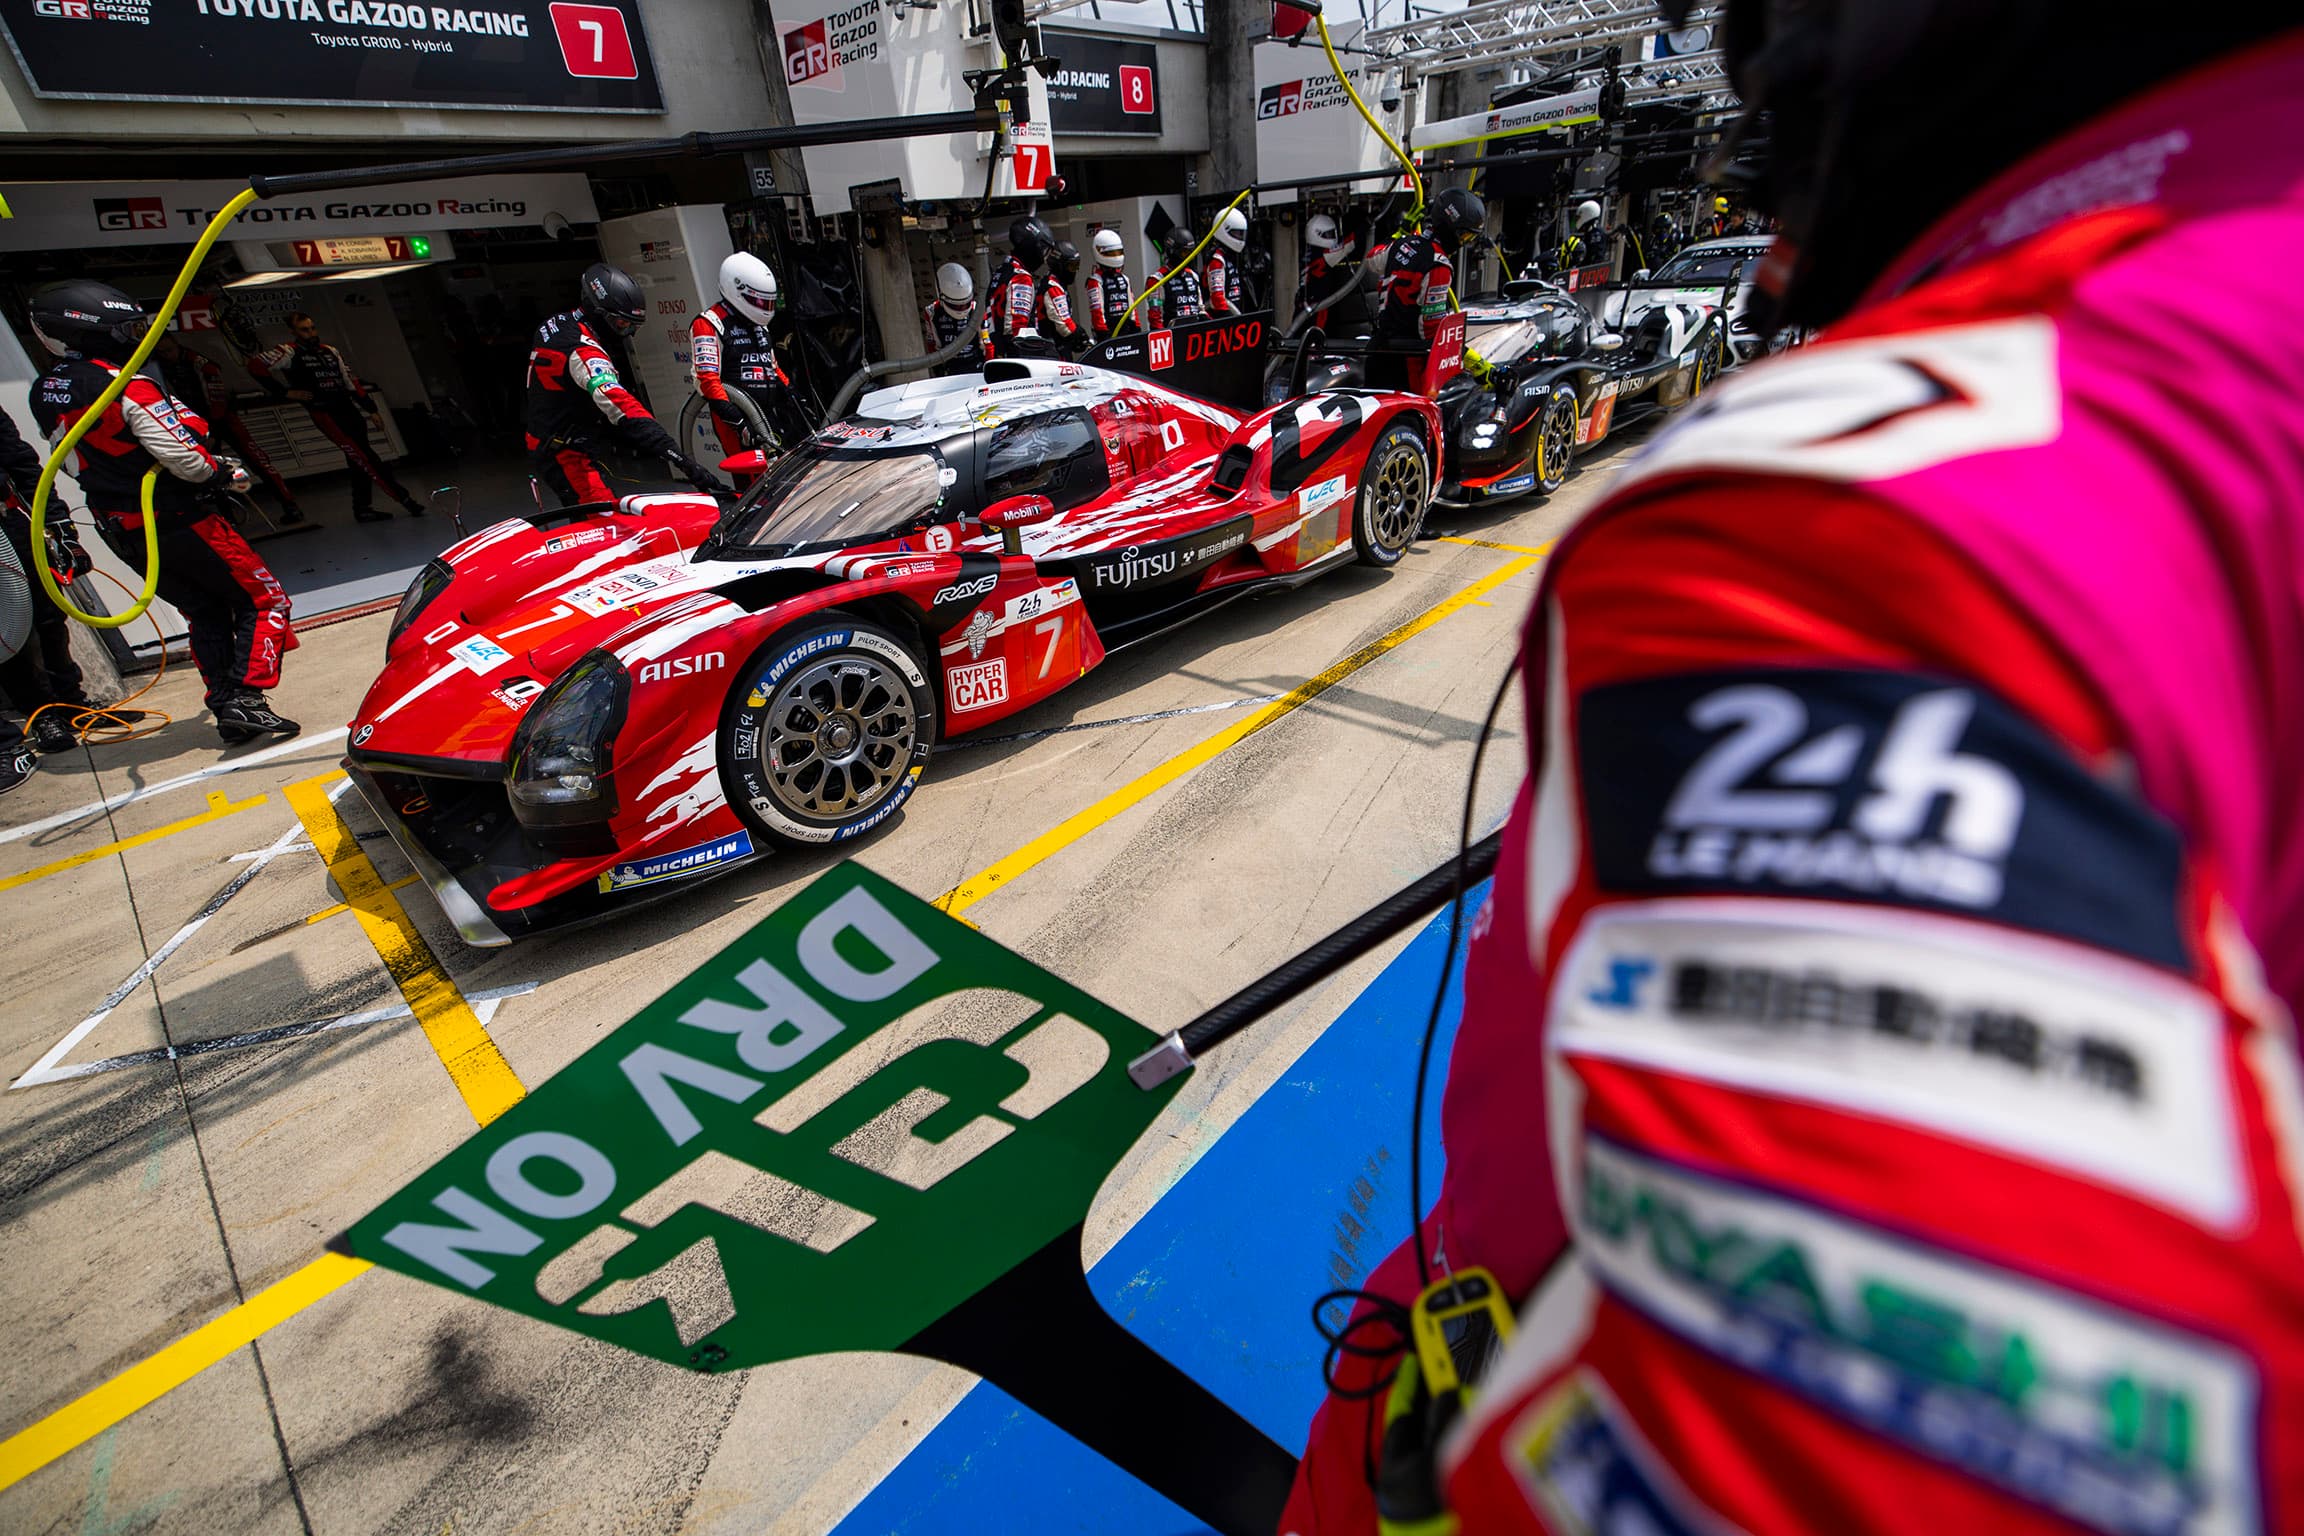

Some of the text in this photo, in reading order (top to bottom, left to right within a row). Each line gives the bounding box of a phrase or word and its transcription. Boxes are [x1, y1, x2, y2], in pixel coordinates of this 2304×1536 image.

[36, 1, 89, 18] GR
[93, 3, 150, 15] GAZOO
[95, 11, 151, 25] Racing
[198, 0, 529, 37] TOYOTA GAZOO RACING
[828, 0, 880, 31] TOYOTA
[311, 33, 358, 49] Toyota
[361, 36, 401, 50] GR010
[412, 39, 454, 54] Hybrid
[579, 20, 603, 63] 7
[830, 21, 877, 50] GAZOO
[788, 44, 828, 83] GR
[832, 42, 878, 69] Racing
[1071, 73, 1110, 89] RACING
[1132, 76, 1144, 104] 8
[1304, 83, 1353, 99] GAZO
[1259, 92, 1302, 119] GR
[1302, 95, 1351, 111] Racing
[1501, 117, 1532, 129] TOYOTA
[1533, 109, 1564, 122] GAZOO
[1565, 103, 1597, 116] Racing
[755, 170, 774, 188] 55
[1022, 146, 1038, 188] 7
[99, 209, 167, 230] GR
[324, 202, 433, 220] GAZOO
[438, 198, 527, 217] Racing
[299, 243, 313, 263] 7
[389, 239, 401, 257] 7
[1691, 249, 1722, 257] IRON
[103, 300, 134, 312] uvex
[658, 299, 686, 315] DENSO
[1186, 321, 1262, 362] DENSO
[1438, 325, 1464, 347] JFE
[1151, 337, 1171, 364] HY
[1058, 365, 1084, 377] ZENT
[1524, 385, 1551, 397] AISIN
[1308, 479, 1338, 502] WEC
[1003, 507, 1033, 522] Mobil
[549, 538, 577, 553] GR
[606, 525, 617, 539] 7
[622, 573, 658, 590] AISIN
[737, 568, 758, 576] FIA
[888, 566, 912, 578] GR
[1095, 551, 1176, 588] FUJITSU
[253, 567, 291, 631] DENO
[933, 574, 998, 605] RAYS
[496, 604, 575, 640] 7
[466, 641, 506, 662] WEC
[769, 633, 845, 682] MICHELIN
[857, 636, 922, 682] PILOT SPORT S
[1035, 615, 1064, 681] 7
[640, 651, 725, 684] AISIN
[953, 663, 1002, 686] HYPER
[955, 677, 1005, 707] CAR
[737, 735, 751, 755] 702
[914, 742, 929, 759] FL
[1664, 682, 2025, 860] 24h
[754, 800, 769, 811] S
[841, 789, 906, 837] MICHELIN
[781, 823, 829, 840] PILOT SPORT
[643, 841, 738, 876] MICHELIN
[1646, 828, 2004, 910] LE MANS
[382, 885, 941, 1290] DRV ON
